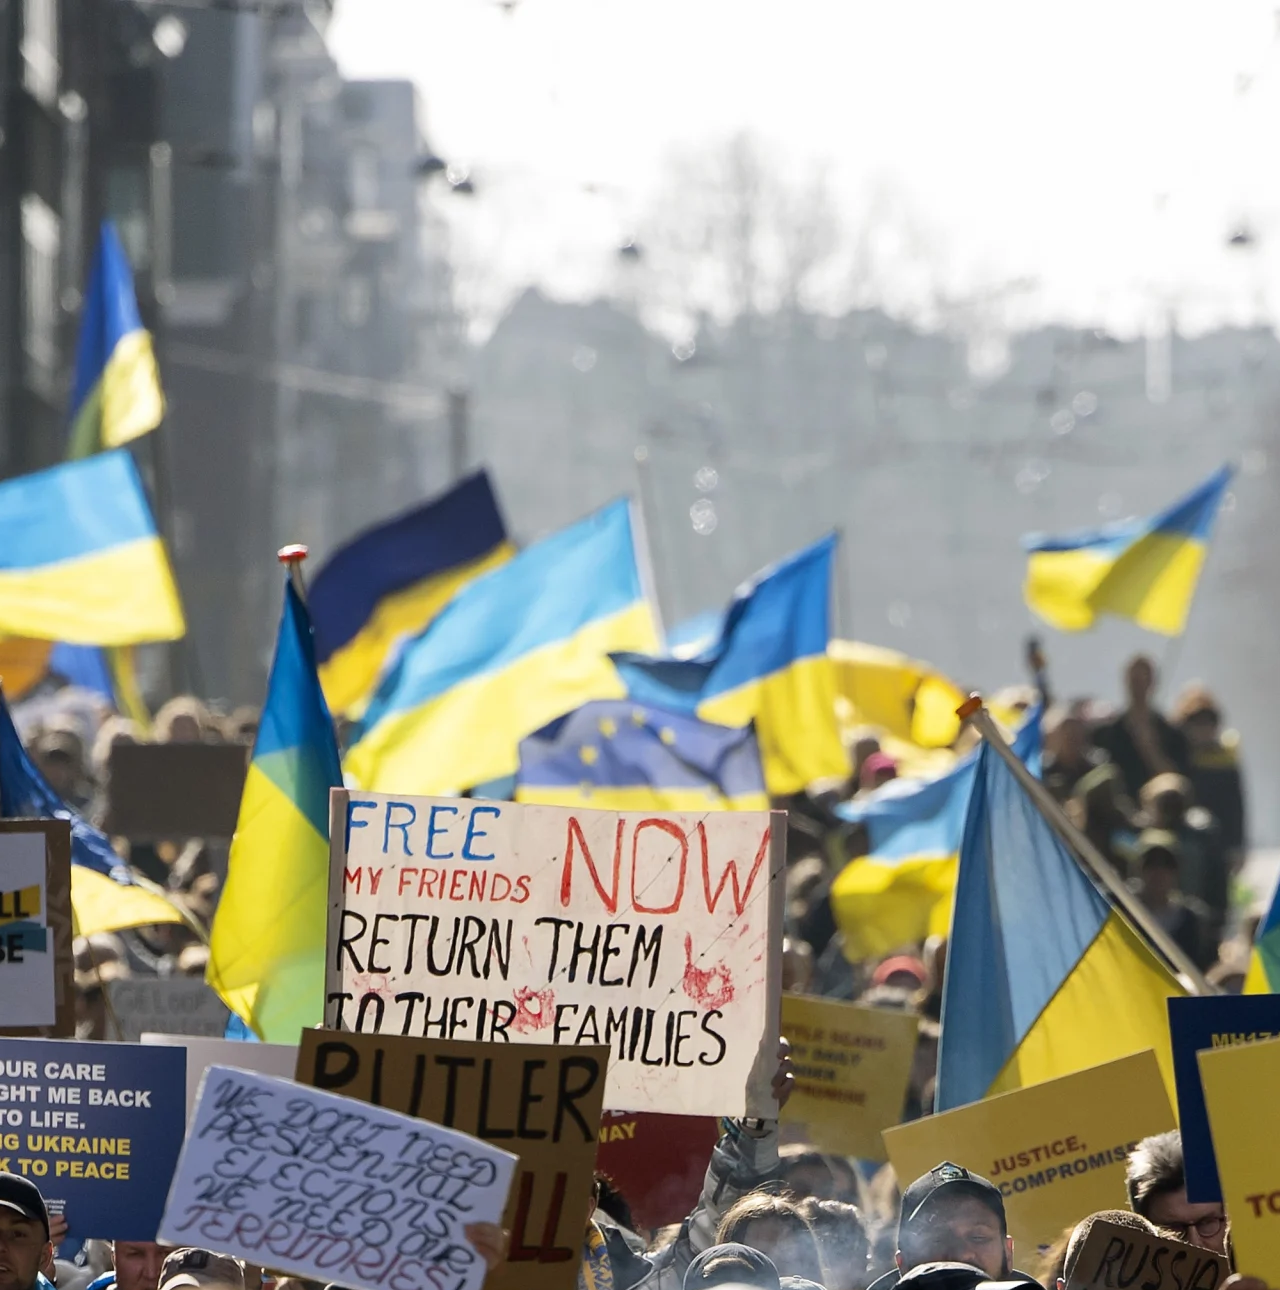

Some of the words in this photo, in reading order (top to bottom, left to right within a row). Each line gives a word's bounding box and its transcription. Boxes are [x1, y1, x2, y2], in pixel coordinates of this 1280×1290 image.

[344, 799, 502, 863] FREE
[559, 815, 771, 917] NOW
[342, 865, 384, 897] MY
[397, 866, 533, 904] FRIENDS
[335, 909, 515, 982] RETURN
[533, 915, 665, 988] THEM
[326, 989, 386, 1034] TO
[394, 991, 519, 1044] THEIR
[551, 1002, 728, 1068] FAMILIES
[44, 1061, 107, 1083] CARE
[47, 1085, 82, 1106] ME
[87, 1088, 152, 1110] BACK
[30, 1109, 86, 1131] LIFE.
[26, 1134, 132, 1157] UKRAINE
[17, 1157, 49, 1178] TO
[55, 1159, 130, 1182] PEACE
